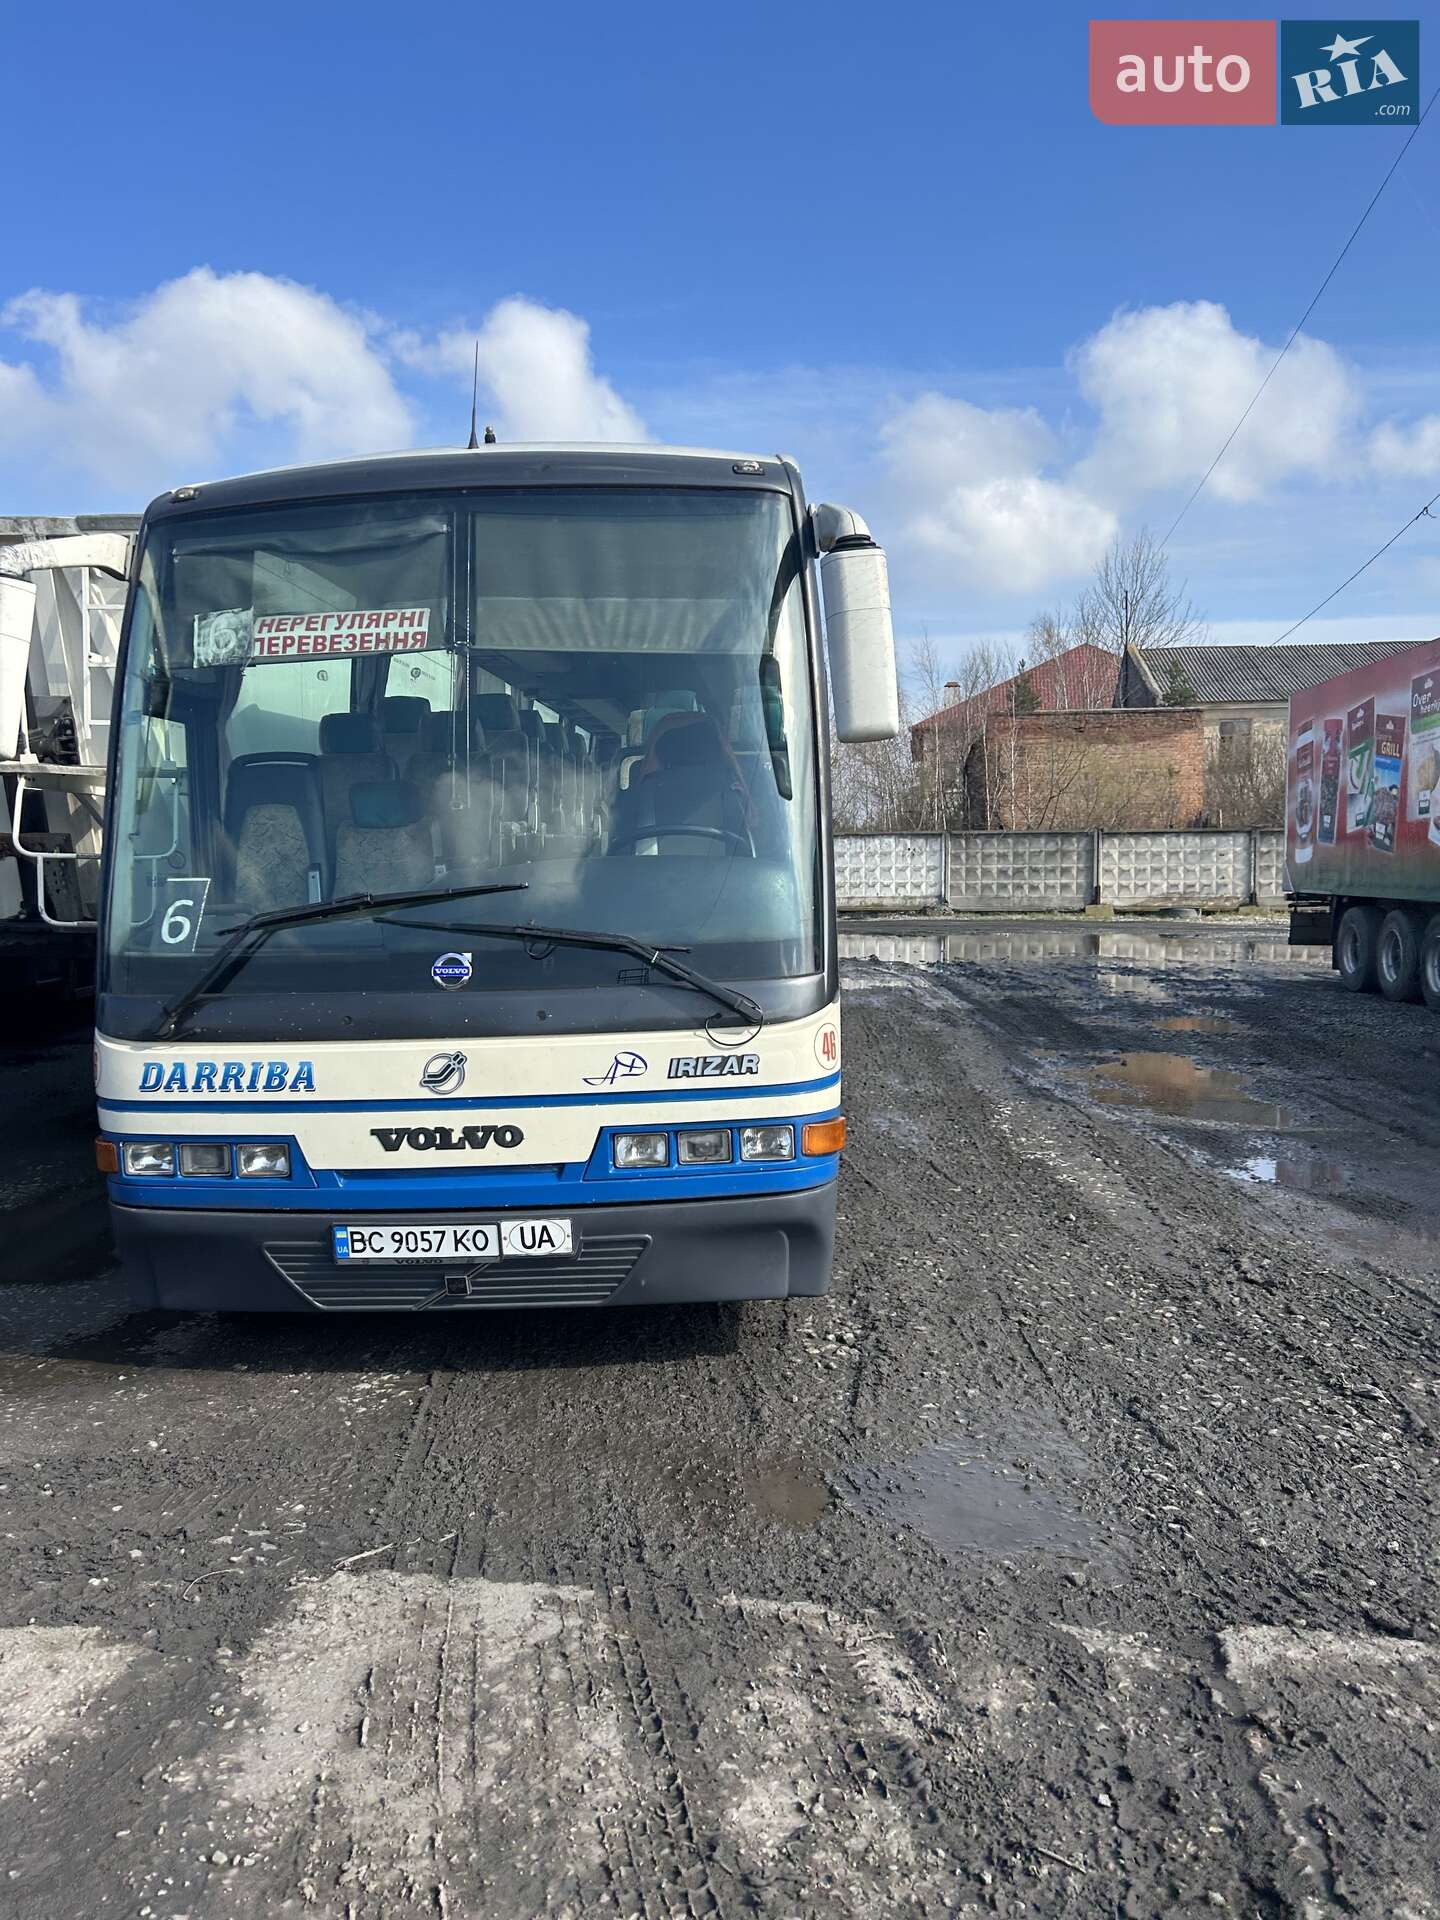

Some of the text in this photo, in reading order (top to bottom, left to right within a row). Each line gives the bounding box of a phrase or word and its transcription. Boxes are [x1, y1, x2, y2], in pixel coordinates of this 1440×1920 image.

[257, 610, 425, 634] НЕРЕГУЛЯРНІ
[1413, 692, 1432, 708] Over
[1381, 741, 1400, 757] GRILL
[161, 899, 194, 944] 6
[822, 1031, 836, 1062] 46
[139, 1061, 315, 1093] DARRIBA
[667, 1054, 760, 1079] IRIZAR
[370, 1125, 524, 1151] VOLVO
[337, 1246, 348, 1254] UA
[350, 1231, 384, 1253] BC
[391, 1230, 446, 1253] 9057
[519, 1225, 556, 1250] UA
